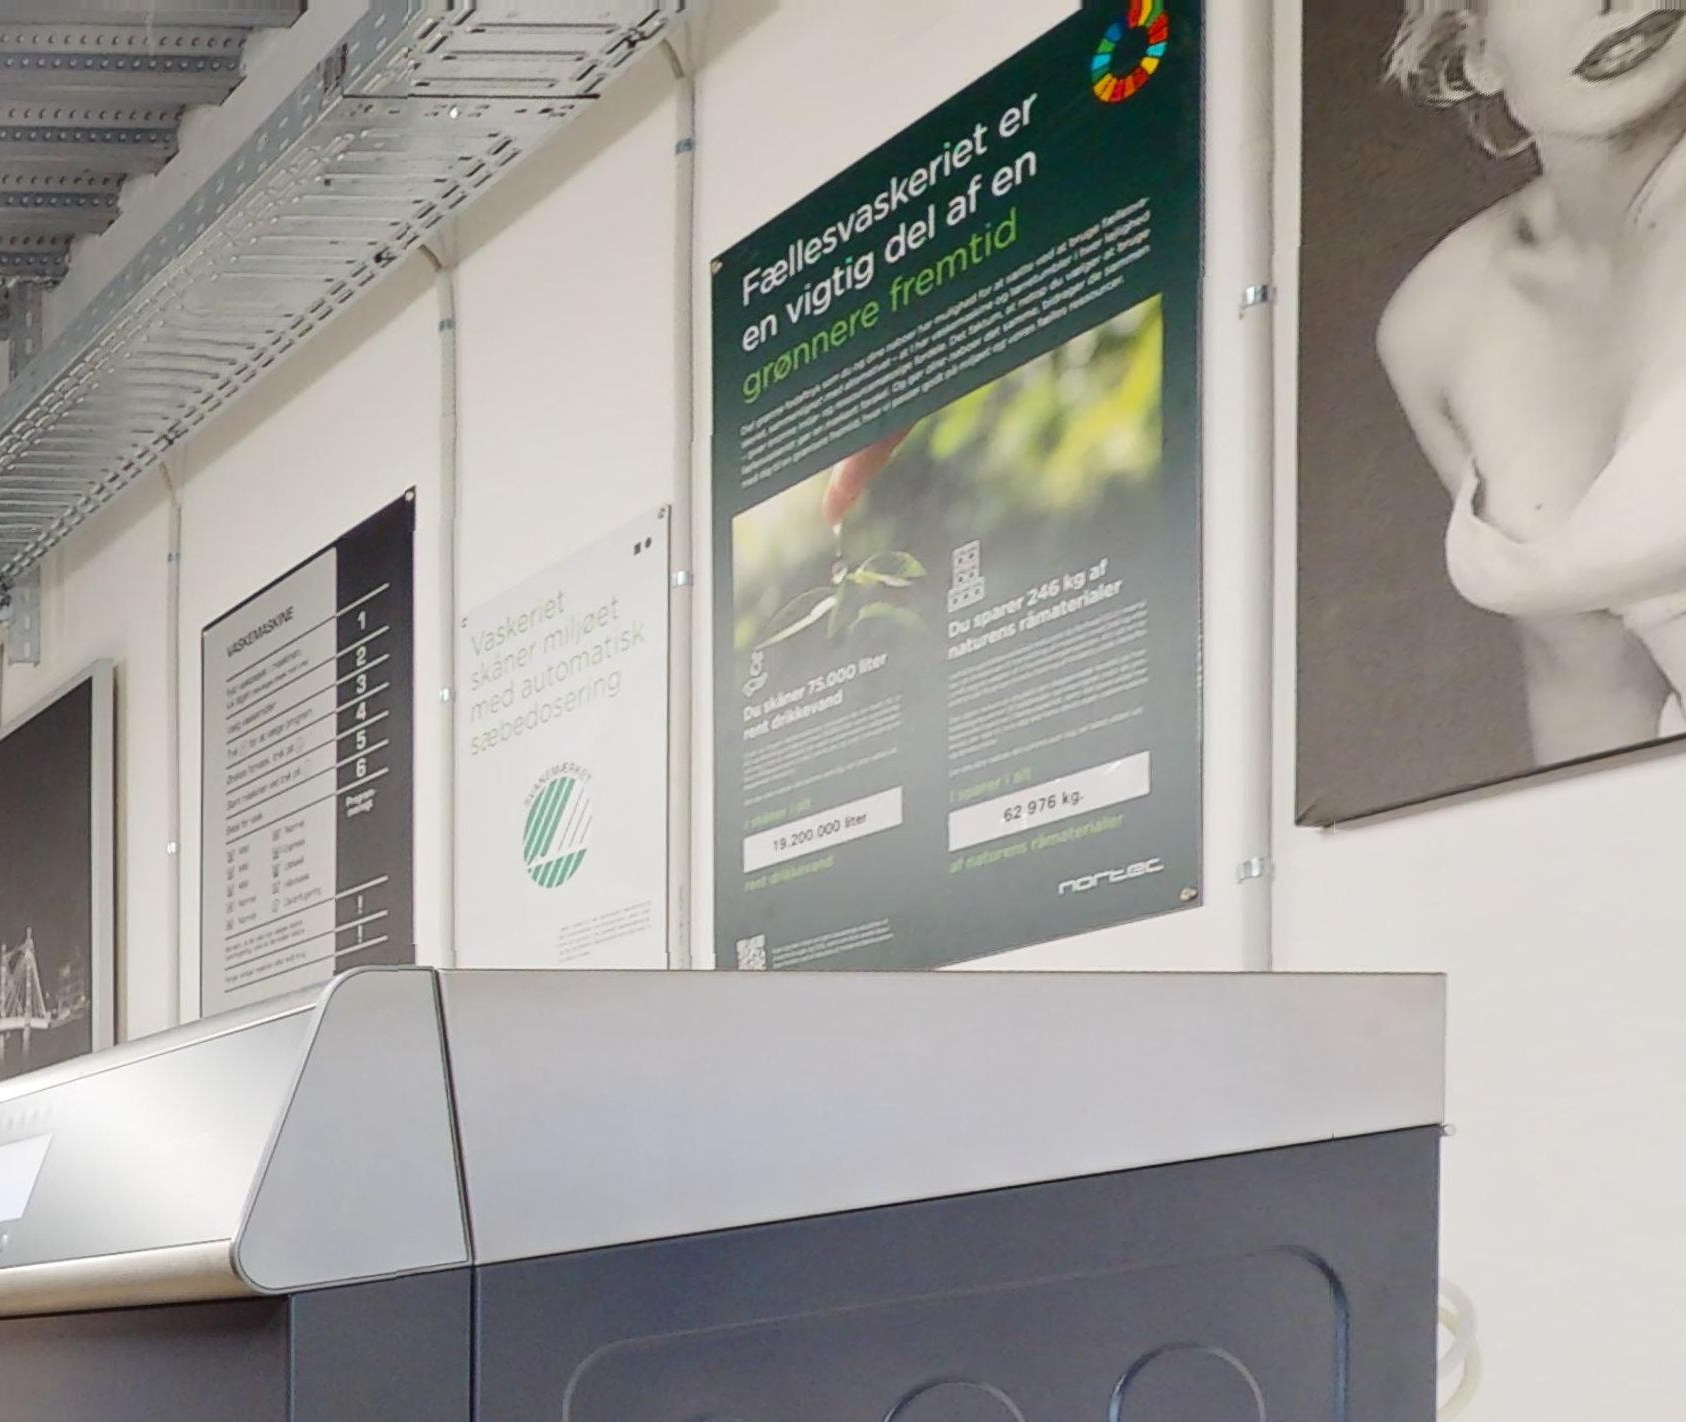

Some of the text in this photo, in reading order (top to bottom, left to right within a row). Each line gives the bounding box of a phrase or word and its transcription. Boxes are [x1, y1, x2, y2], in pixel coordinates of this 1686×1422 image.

[743, 93, 1037, 306] Fællesvaskeriet er
[742, 150, 1037, 351] en vigtig del af en
[742, 300, 879, 404] grønnere
[890, 206, 1017, 312] fremtid
[948, 557, 1108, 639] Du sparer 246 kg af
[357, 610, 367, 630] 1
[471, 589, 564, 657] Vaskeriet
[356, 646, 367, 667] 2
[471, 596, 619, 692] skåner miljøet
[948, 622, 1017, 660] naturens
[356, 674, 367, 694] 3
[471, 619, 645, 724] med automatisk
[355, 701, 367, 721] 4
[471, 670, 621, 756] sæbedosering
[356, 729, 367, 750] 5
[356, 757, 367, 778] 6
[1003, 805, 1022, 823] 62
[1028, 794, 1057, 815] 976
[1059, 856, 1164, 895] nortec
